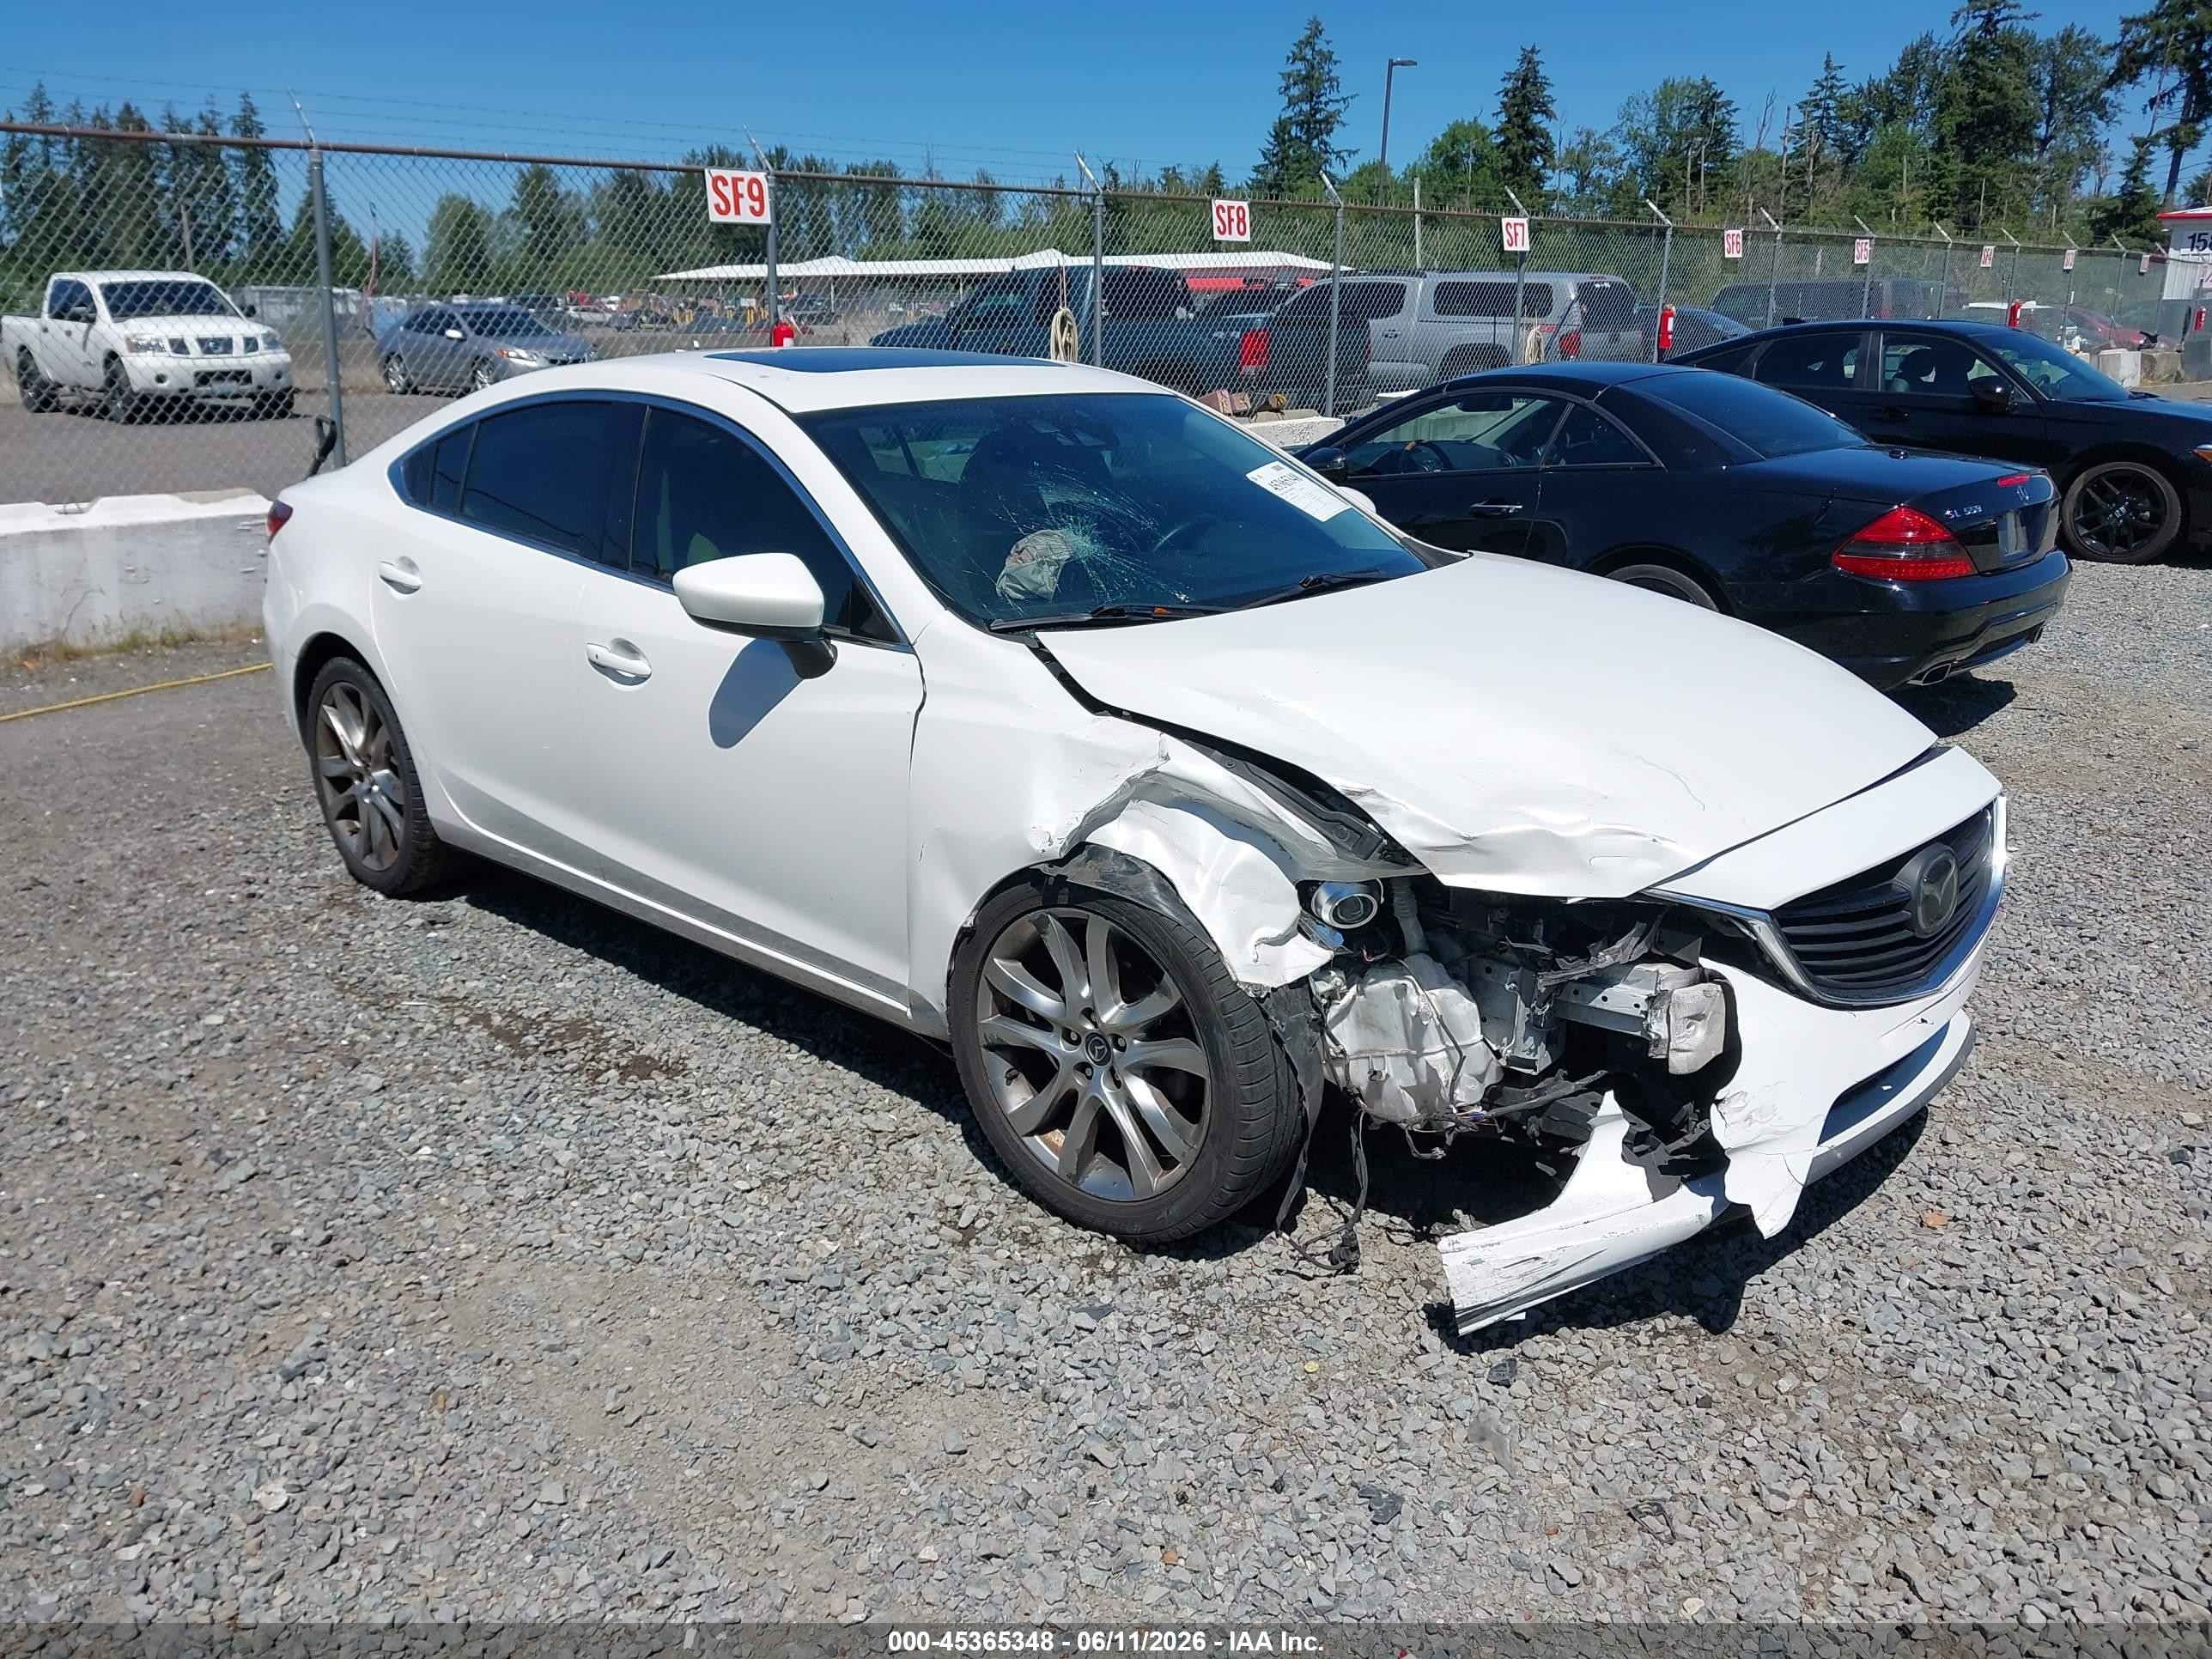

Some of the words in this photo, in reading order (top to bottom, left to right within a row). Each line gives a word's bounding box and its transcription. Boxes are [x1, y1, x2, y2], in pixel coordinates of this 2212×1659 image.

[712, 175, 765, 216] SF9
[1216, 204, 1247, 236] SF8
[1505, 222, 1525, 247] SF7
[1726, 234, 1741, 254] SF6
[1856, 241, 1869, 261] SF5
